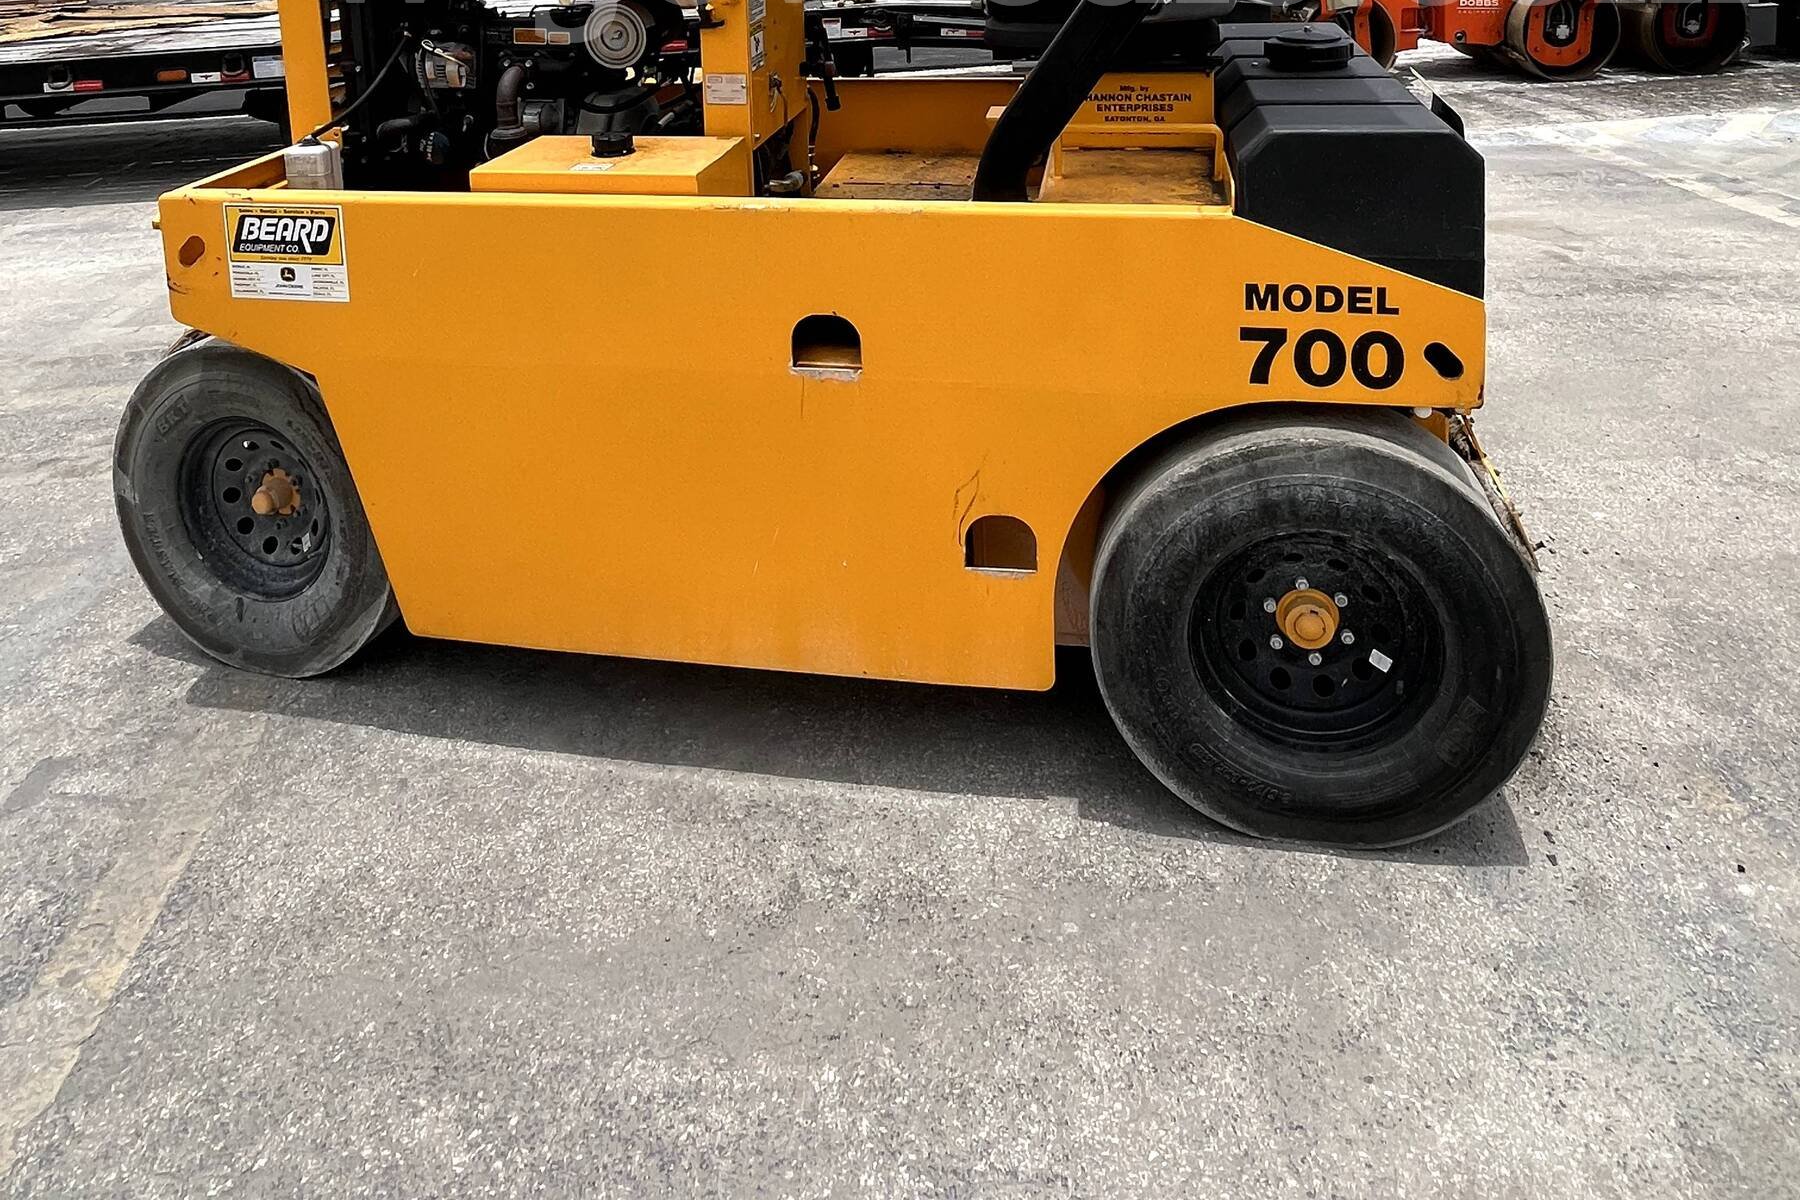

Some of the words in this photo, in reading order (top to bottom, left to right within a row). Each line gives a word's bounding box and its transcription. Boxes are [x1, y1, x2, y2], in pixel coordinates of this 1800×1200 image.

[1086, 93, 1132, 102] HANNON
[1136, 93, 1191, 102] CHASTAIN
[1096, 103, 1174, 112] ENTERPRISES
[241, 217, 329, 253] BEARD
[240, 243, 285, 252] EQUIPMENT
[286, 244, 299, 253] CO.
[1244, 283, 1400, 315] MODEL
[1240, 327, 1405, 389] 700
